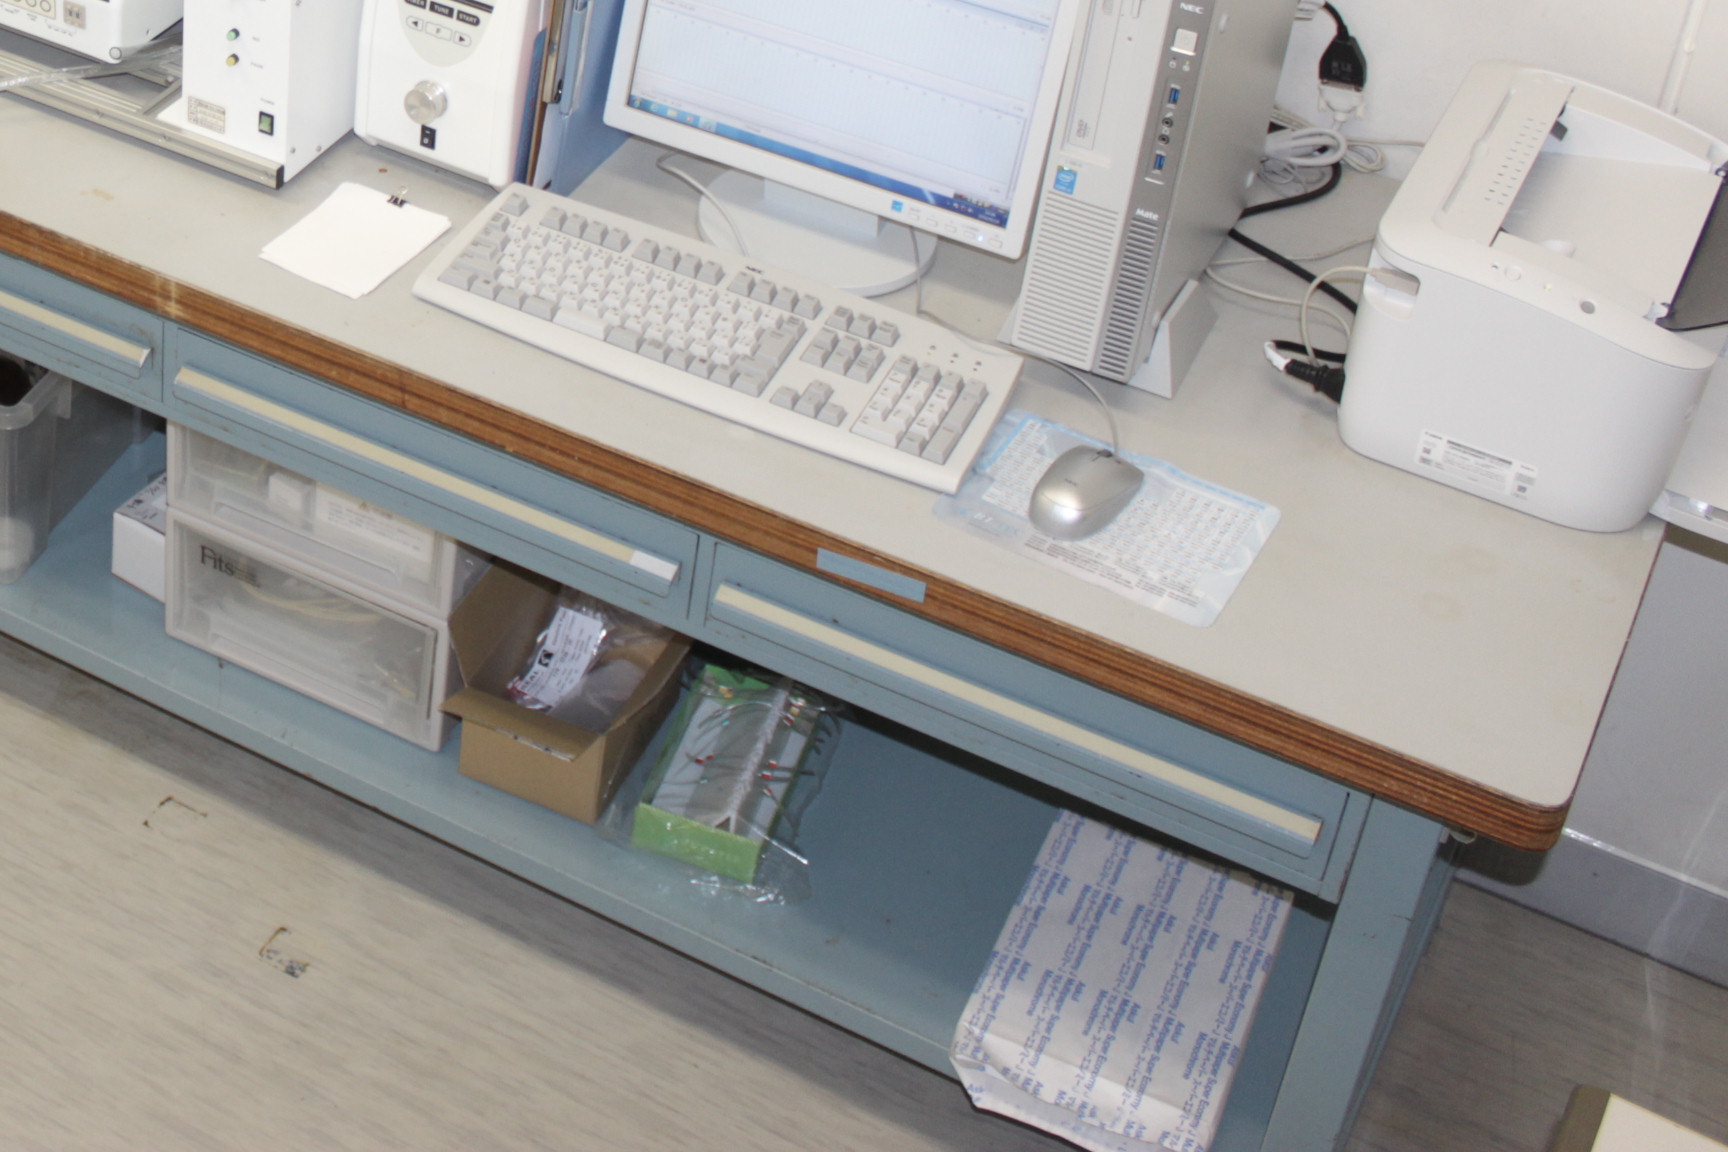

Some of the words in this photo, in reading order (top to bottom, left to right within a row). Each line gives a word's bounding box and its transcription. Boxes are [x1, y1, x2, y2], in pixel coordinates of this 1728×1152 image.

[434, 5, 450, 15] TUNE
[1179, 2, 1204, 15] NEC
[459, 13, 478, 24] START
[1135, 208, 1159, 221] Mate
[1026, 968, 1053, 1016] Monochrome
[1082, 988, 1108, 1035] Monochrome
[1183, 1031, 1208, 1079] Monochrome
